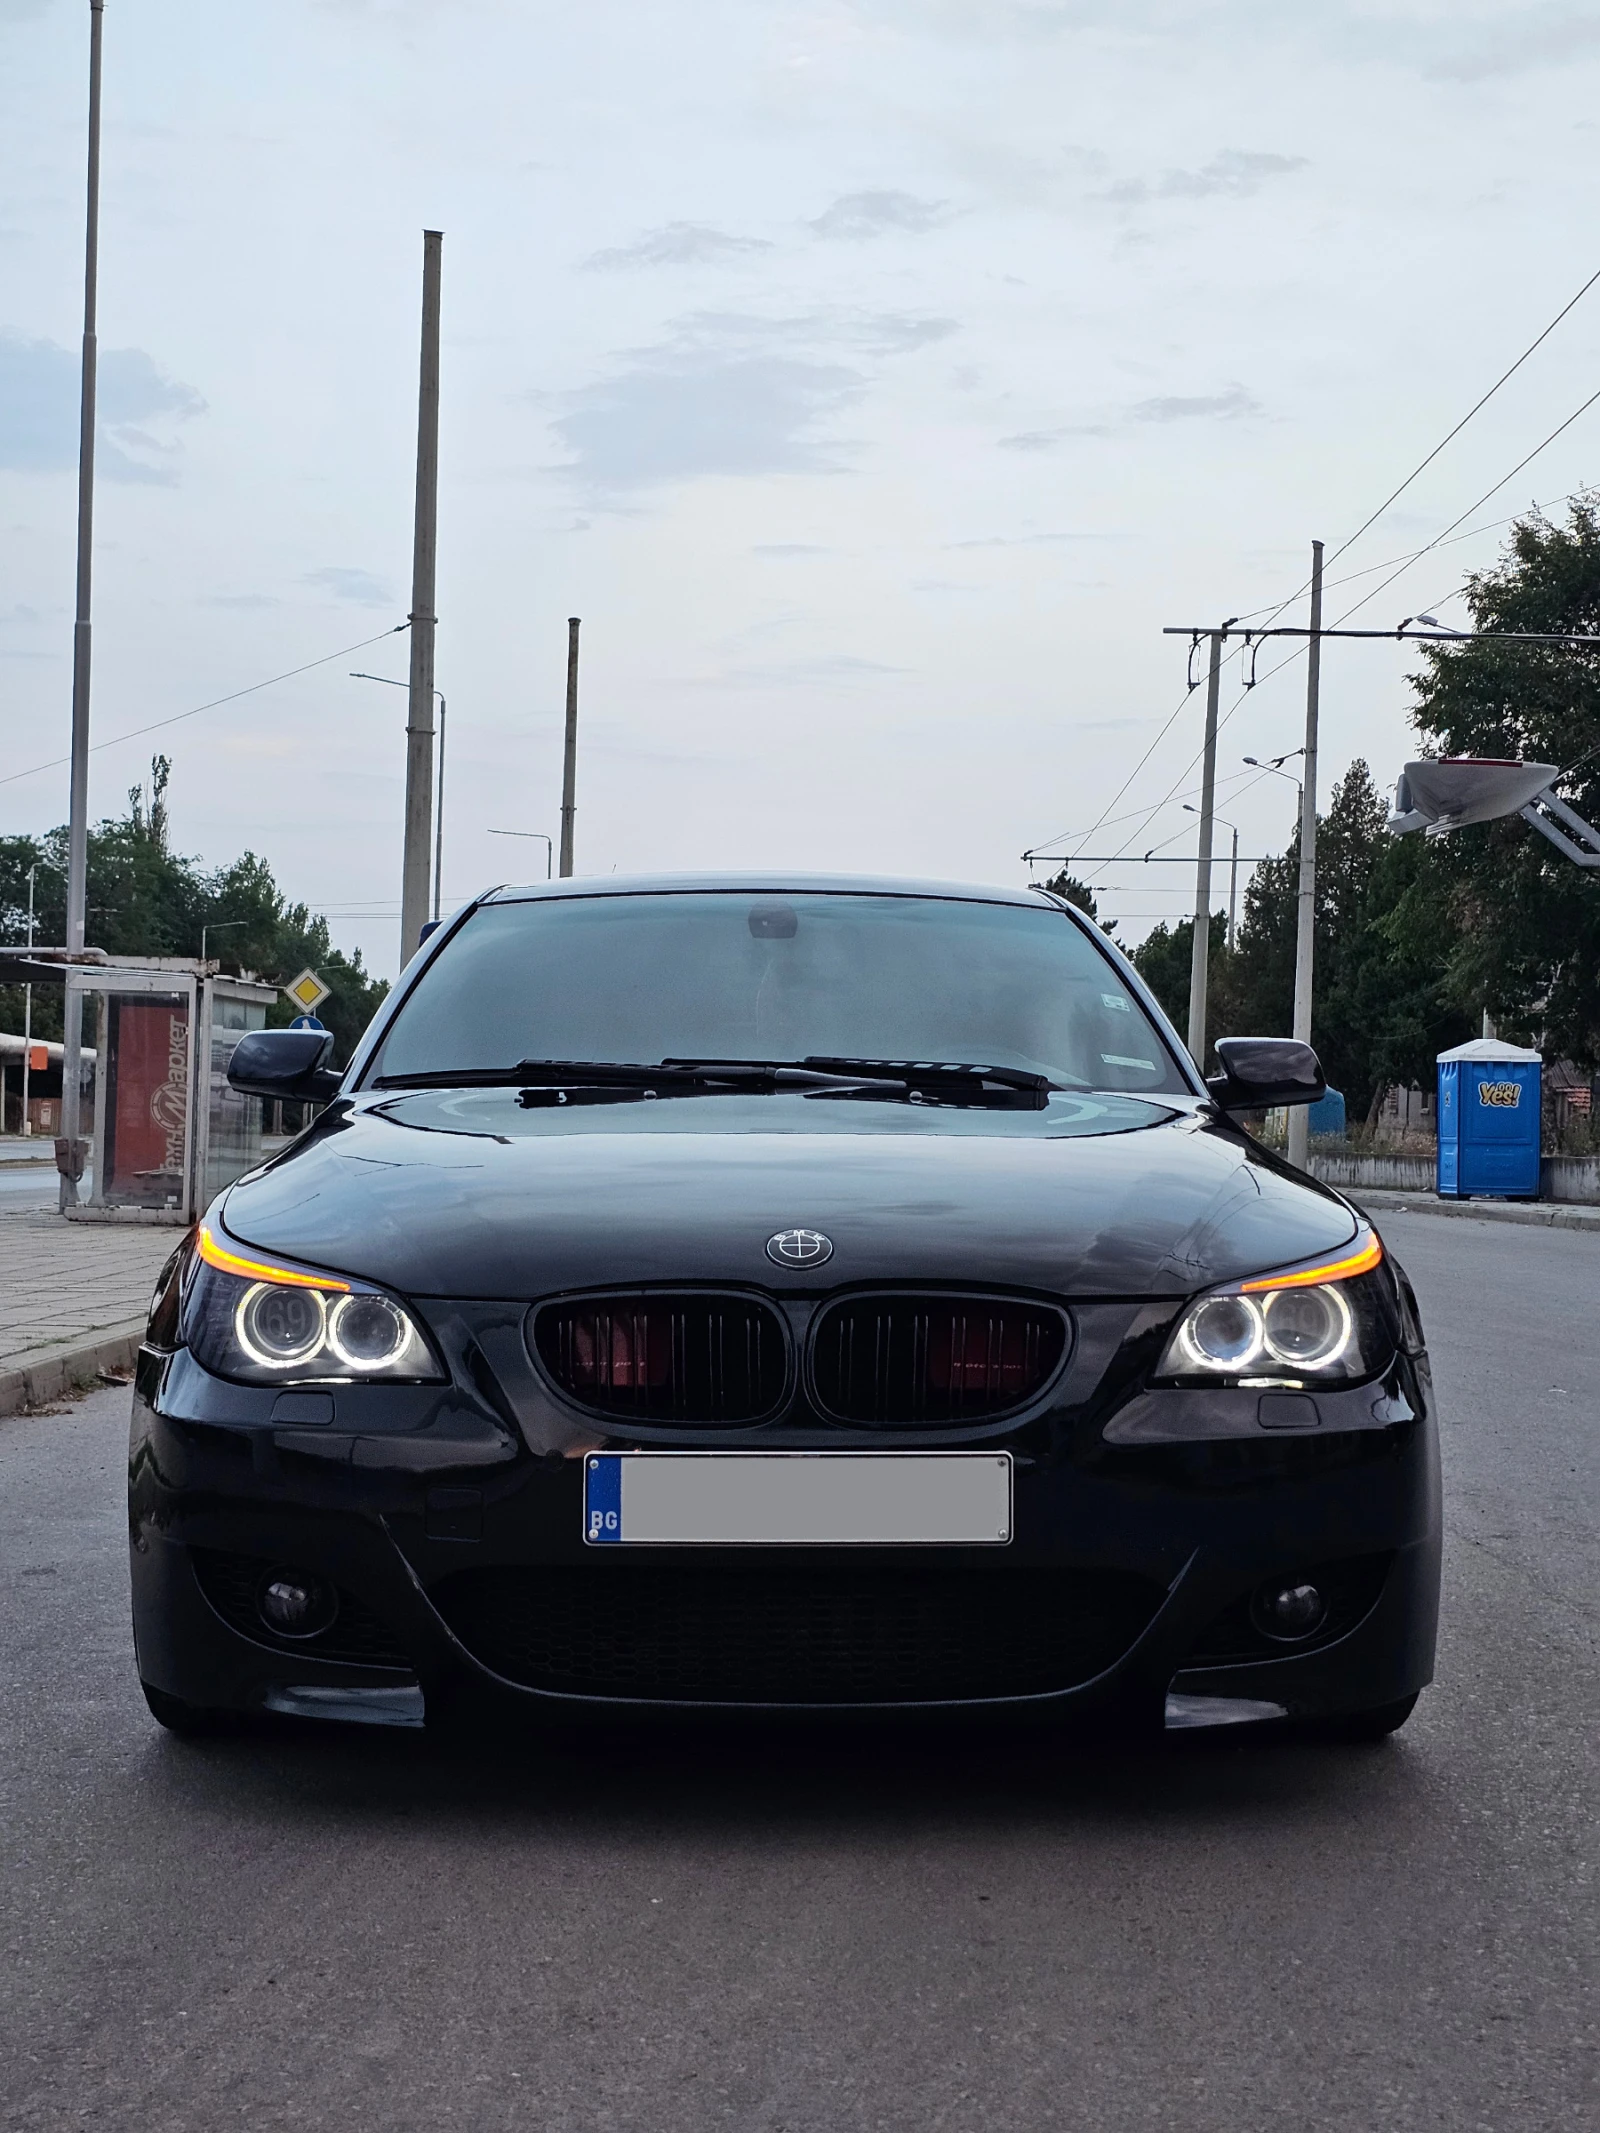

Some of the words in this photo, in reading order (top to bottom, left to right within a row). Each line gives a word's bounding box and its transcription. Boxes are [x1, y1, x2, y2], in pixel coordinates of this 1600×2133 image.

[1479, 1081, 1521, 1107] Yes!
[774, 1229, 825, 1241] BMW
[591, 1511, 618, 1530] BG
